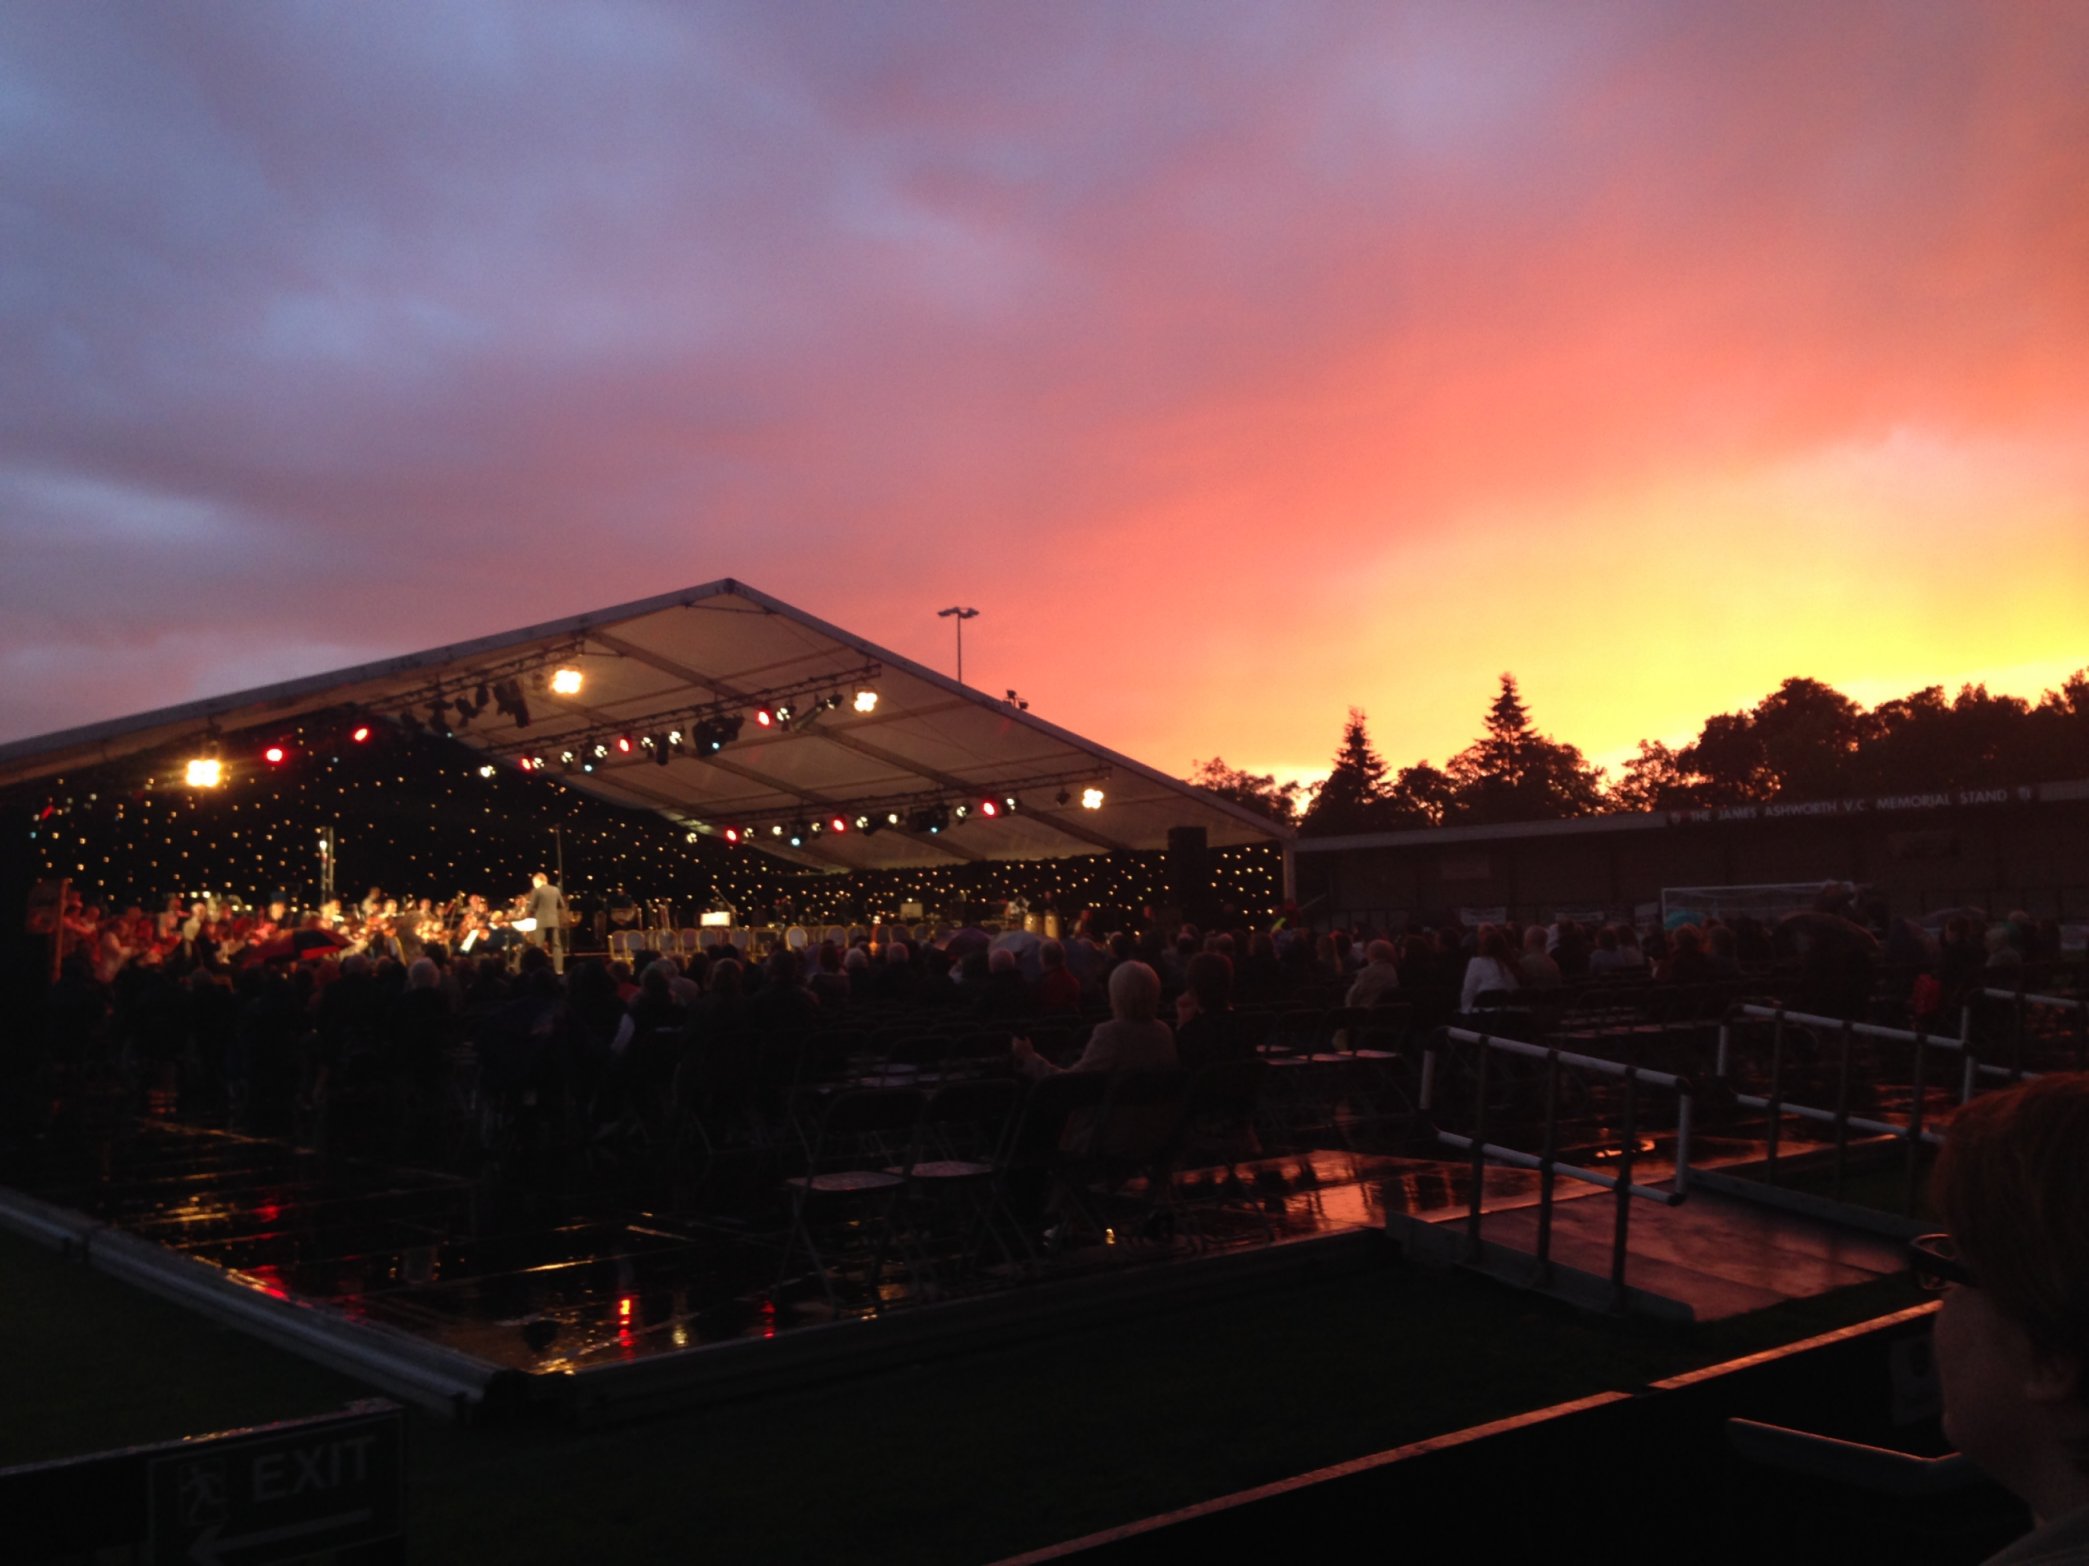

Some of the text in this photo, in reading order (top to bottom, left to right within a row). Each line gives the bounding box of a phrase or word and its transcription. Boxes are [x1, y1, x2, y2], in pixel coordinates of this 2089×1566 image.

[1718, 807, 1756, 820] JAMES
[1765, 801, 1837, 816] ASHWORTH
[1876, 794, 1952, 809] MEMORIAL
[1959, 789, 2007, 803] STAND
[252, 1435, 377, 1504] EXIT
